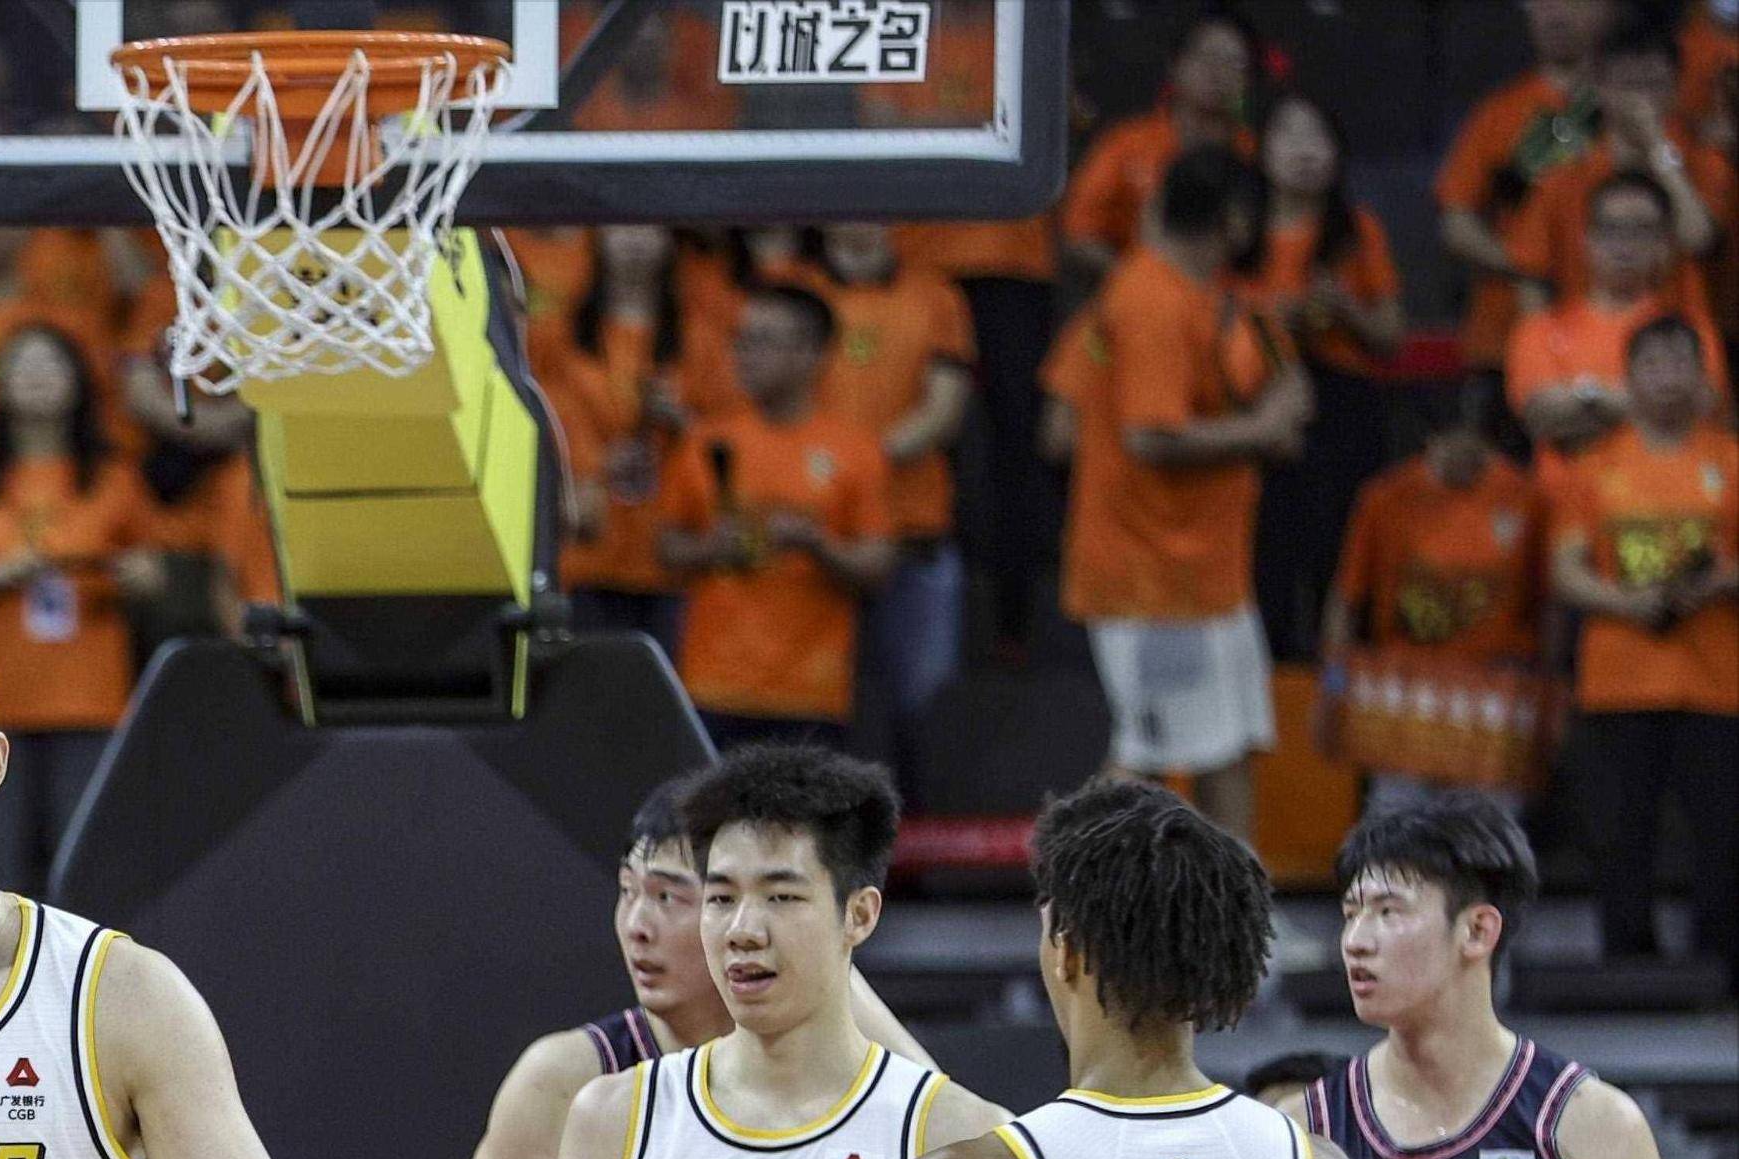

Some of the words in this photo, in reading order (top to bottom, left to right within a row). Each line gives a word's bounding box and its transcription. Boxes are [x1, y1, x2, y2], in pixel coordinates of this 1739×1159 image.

[0, 1095, 45, 1107] 广发银行
[8, 1109, 35, 1120] CGB
